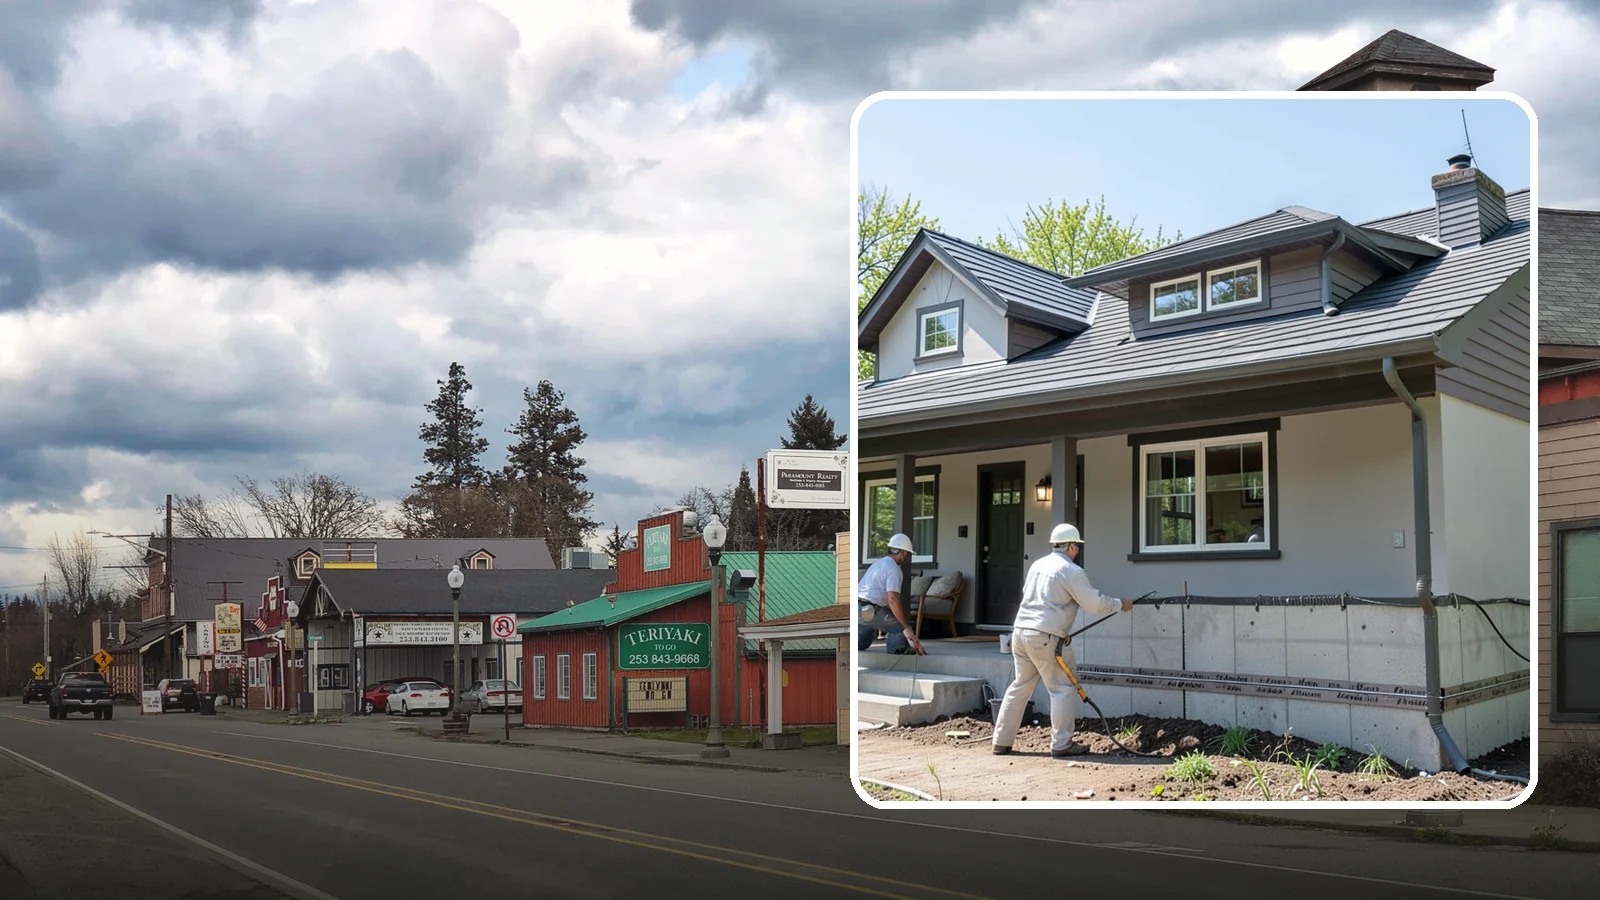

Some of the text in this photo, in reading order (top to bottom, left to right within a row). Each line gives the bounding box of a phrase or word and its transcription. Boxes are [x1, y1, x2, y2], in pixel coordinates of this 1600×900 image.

[625, 627, 702, 646] TERIYAKI
[629, 653, 700, 664] 253 843-9668
